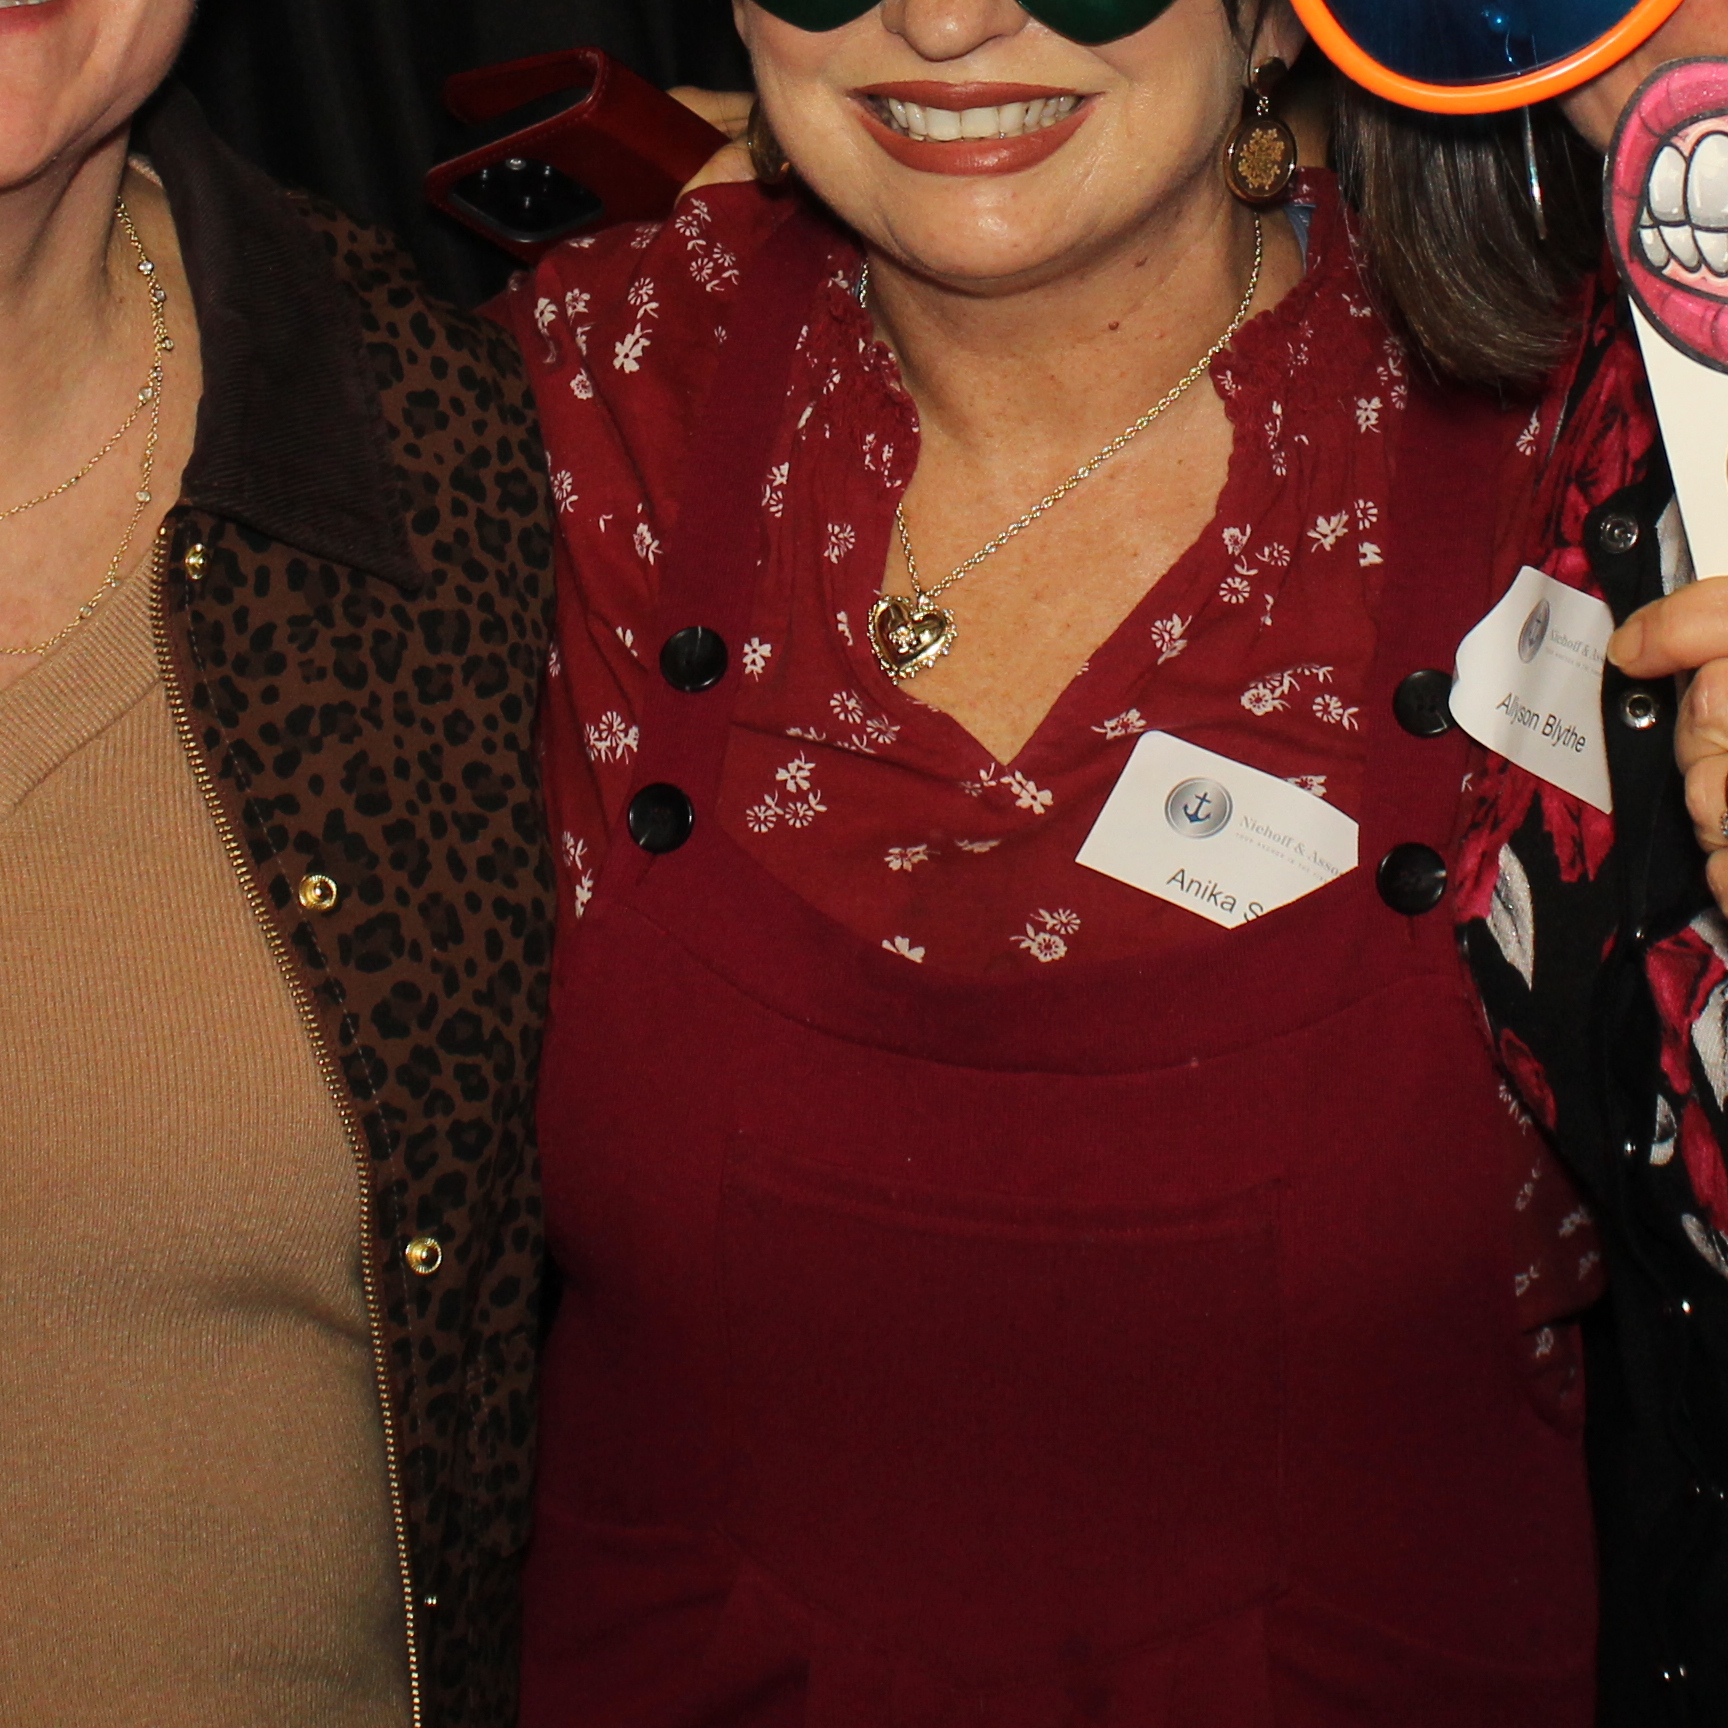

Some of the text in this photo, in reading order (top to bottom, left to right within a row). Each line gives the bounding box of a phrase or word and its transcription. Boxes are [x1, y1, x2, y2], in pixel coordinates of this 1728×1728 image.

[1496, 693, 1586, 753] Allyson Blythe
[1239, 815, 1343, 877] Niehoff & Asso
[1167, 868, 1236, 914] Anika
